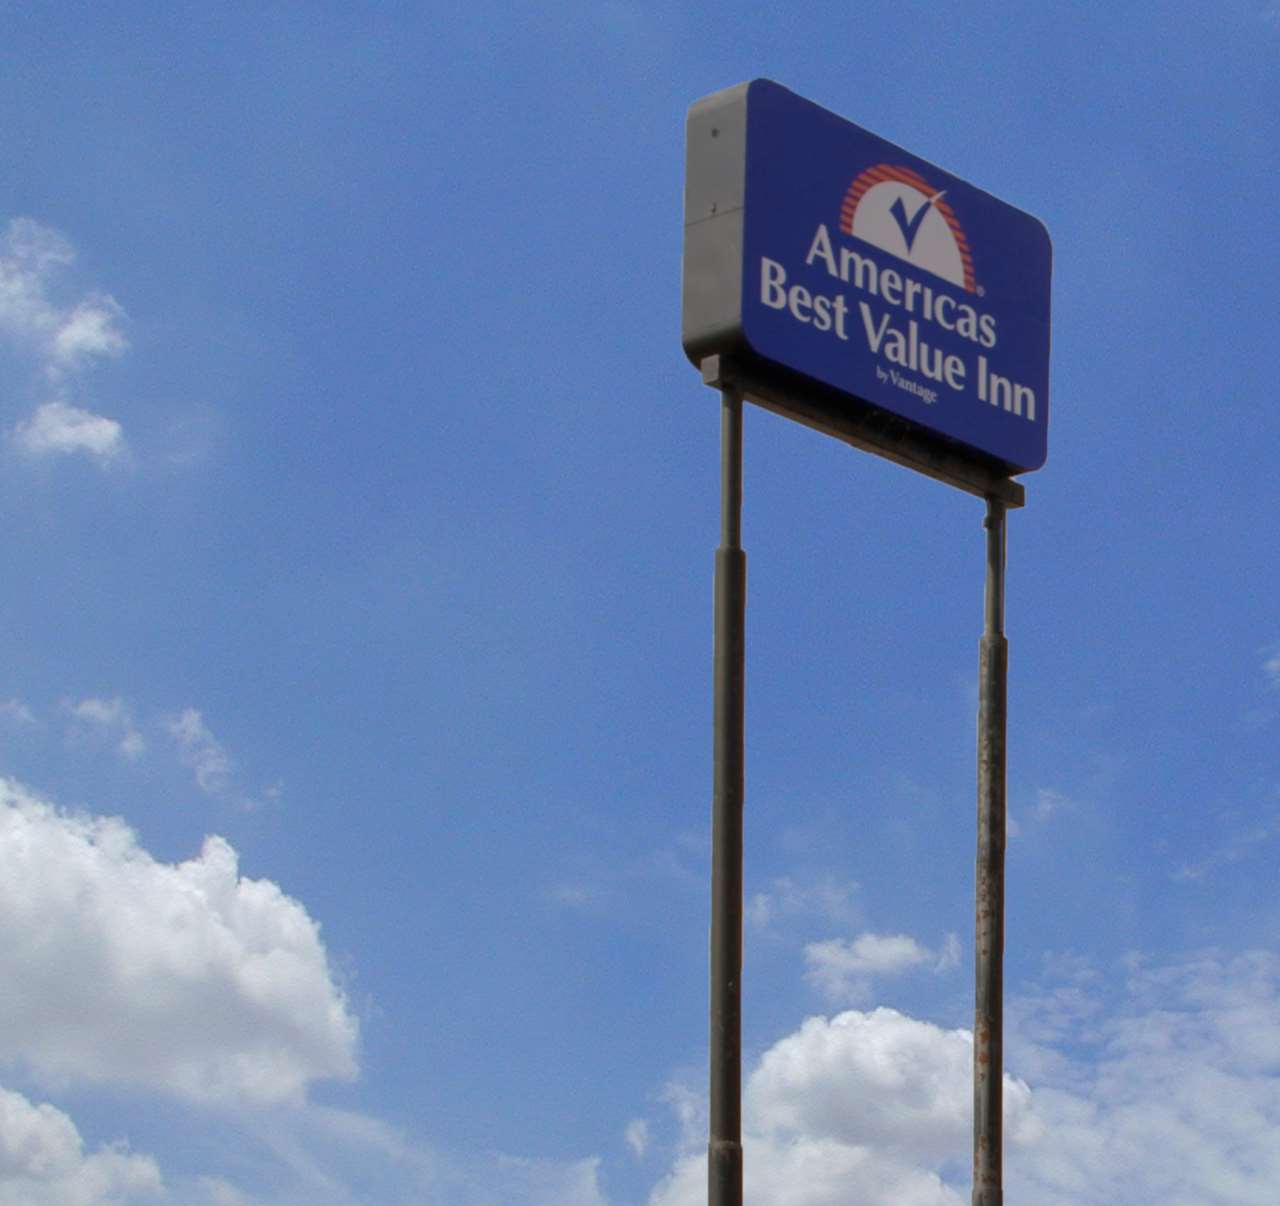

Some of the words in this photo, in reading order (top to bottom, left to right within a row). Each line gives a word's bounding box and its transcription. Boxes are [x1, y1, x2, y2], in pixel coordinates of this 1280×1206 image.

[760, 257, 848, 340] Best
[859, 302, 966, 391] Value
[978, 355, 1035, 421] Inn
[807, 223, 996, 348] Americas
[876, 365, 889, 384] by
[890, 369, 938, 403] Vantage
